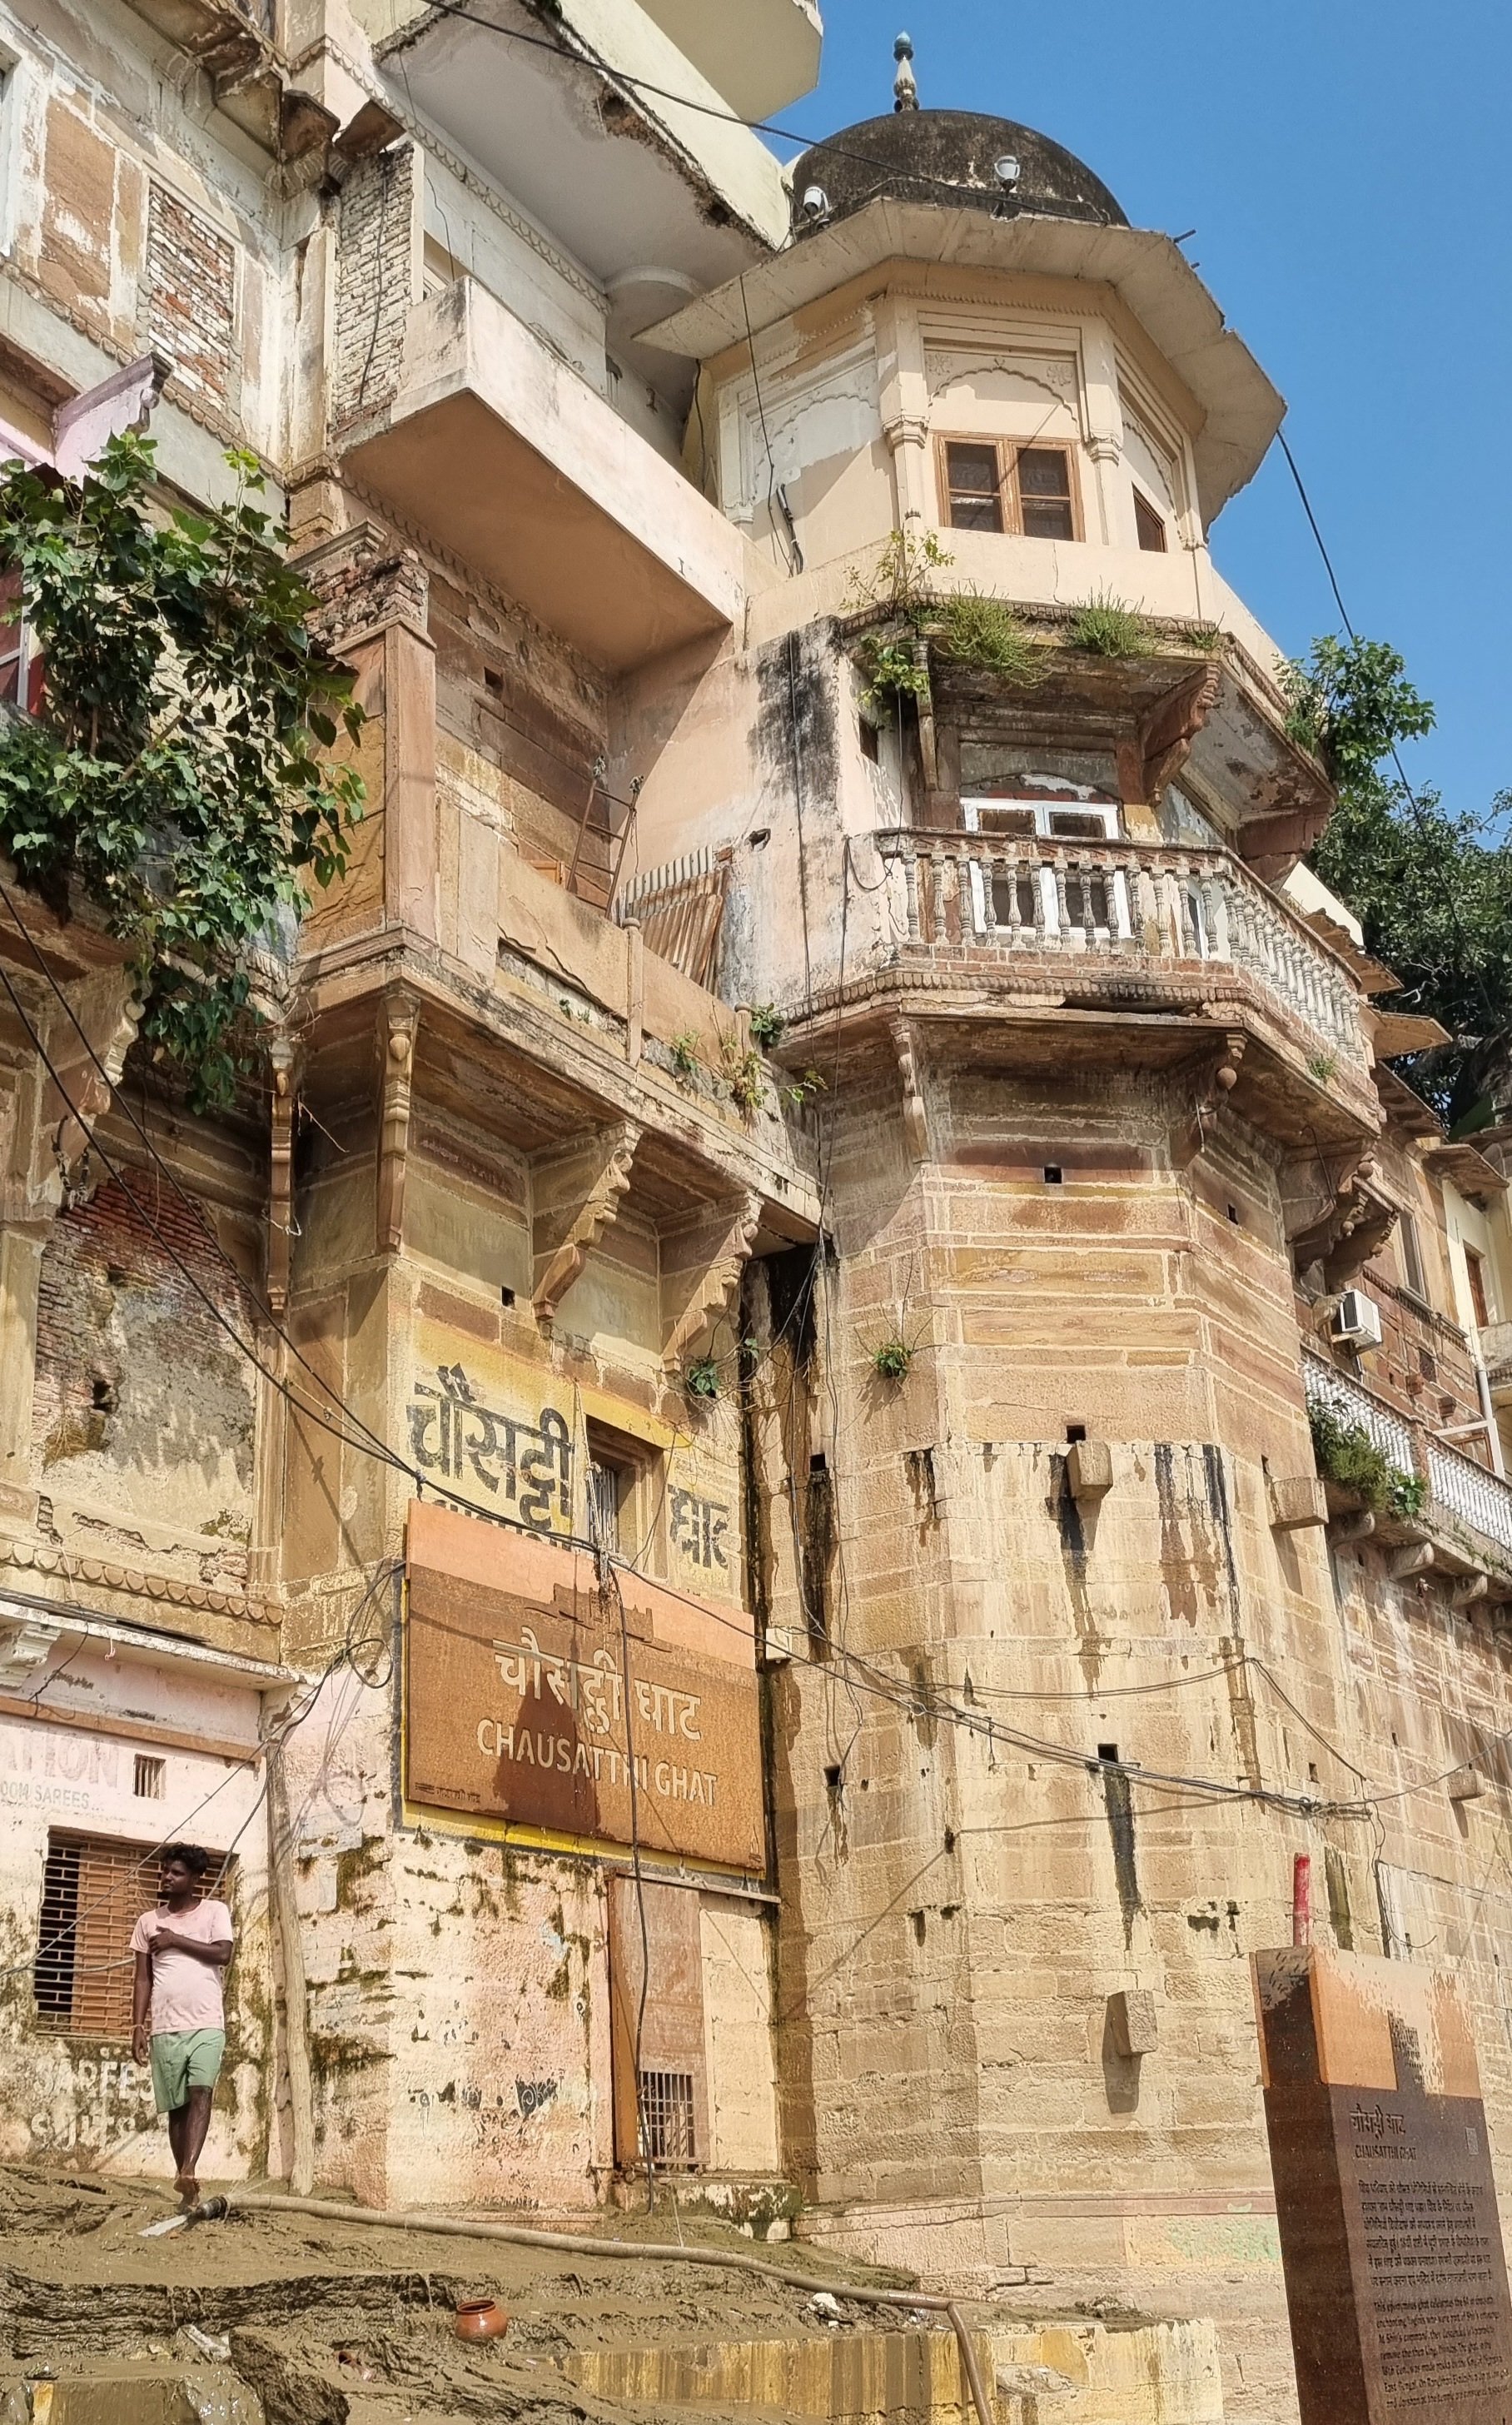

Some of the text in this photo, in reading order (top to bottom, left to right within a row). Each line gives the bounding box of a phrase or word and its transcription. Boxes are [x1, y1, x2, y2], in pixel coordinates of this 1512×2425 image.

[634, 1678, 702, 1740] घाट
[476, 1718, 718, 1806] CHAUSATTHI GHAT
